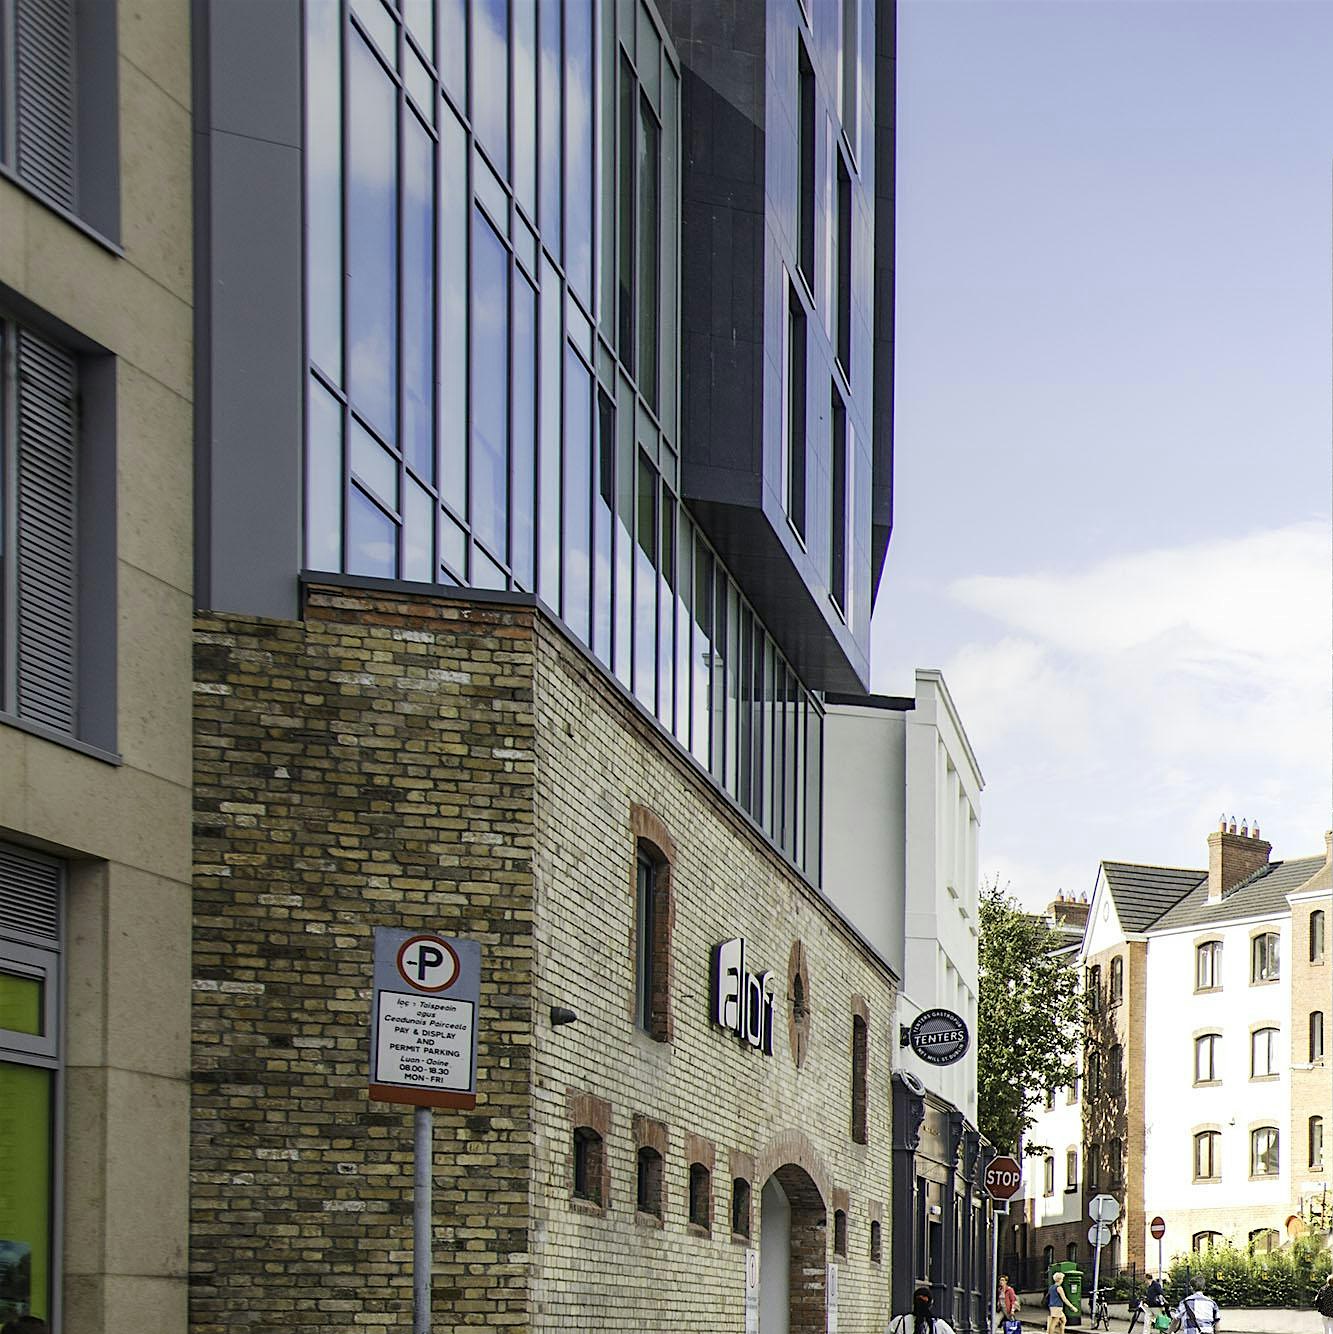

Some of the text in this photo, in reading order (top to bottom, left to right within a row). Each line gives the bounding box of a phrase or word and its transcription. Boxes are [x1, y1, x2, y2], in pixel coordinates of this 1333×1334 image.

[418, 945, 443, 980] P
[394, 1026, 410, 1034] PAY
[422, 1029, 456, 1040] DISPLAY
[914, 1030, 964, 1046] TENTERS
[416, 1038, 435, 1046] AND
[389, 1043, 460, 1058] PERMIT PARKING
[986, 1171, 1020, 1187] STOP
